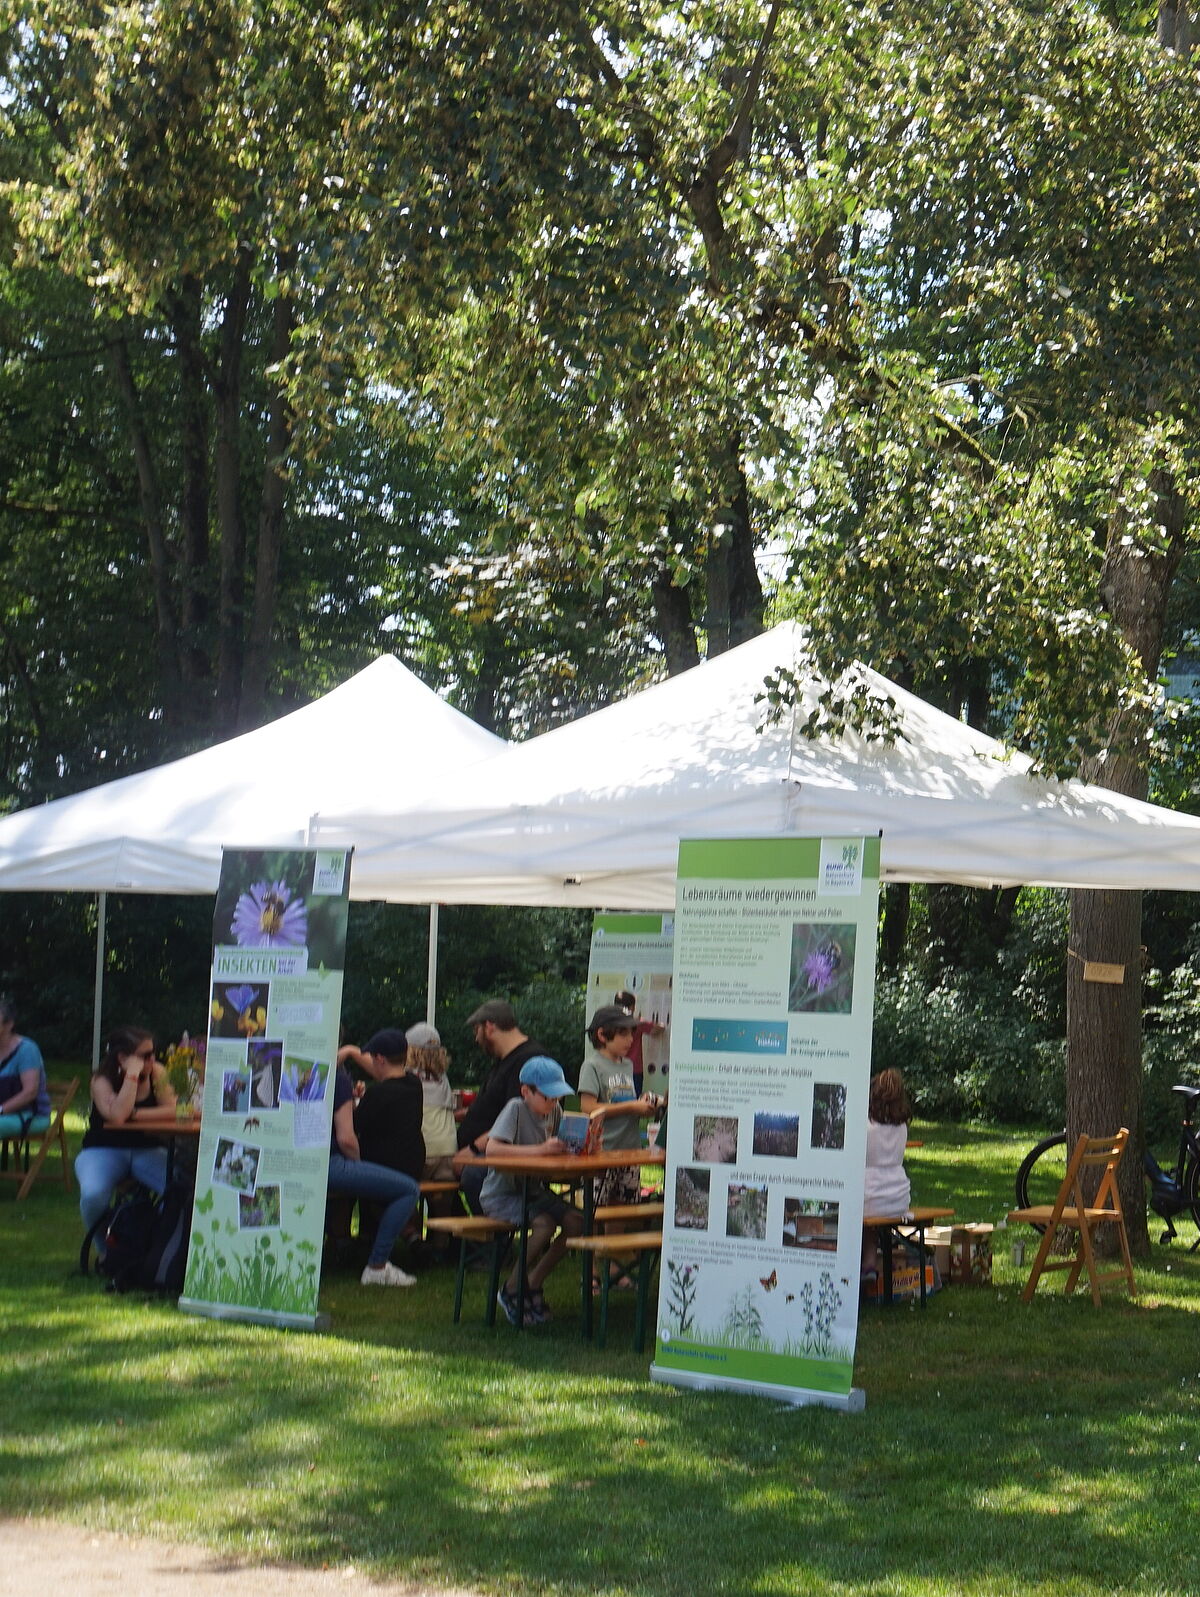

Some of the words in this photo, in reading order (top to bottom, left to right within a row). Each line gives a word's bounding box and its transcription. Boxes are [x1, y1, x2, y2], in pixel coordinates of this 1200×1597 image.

[682, 886, 743, 901] Lebensräume
[745, 886, 817, 905] wiedergewinnen
[217, 957, 277, 974] INSEKTEN
